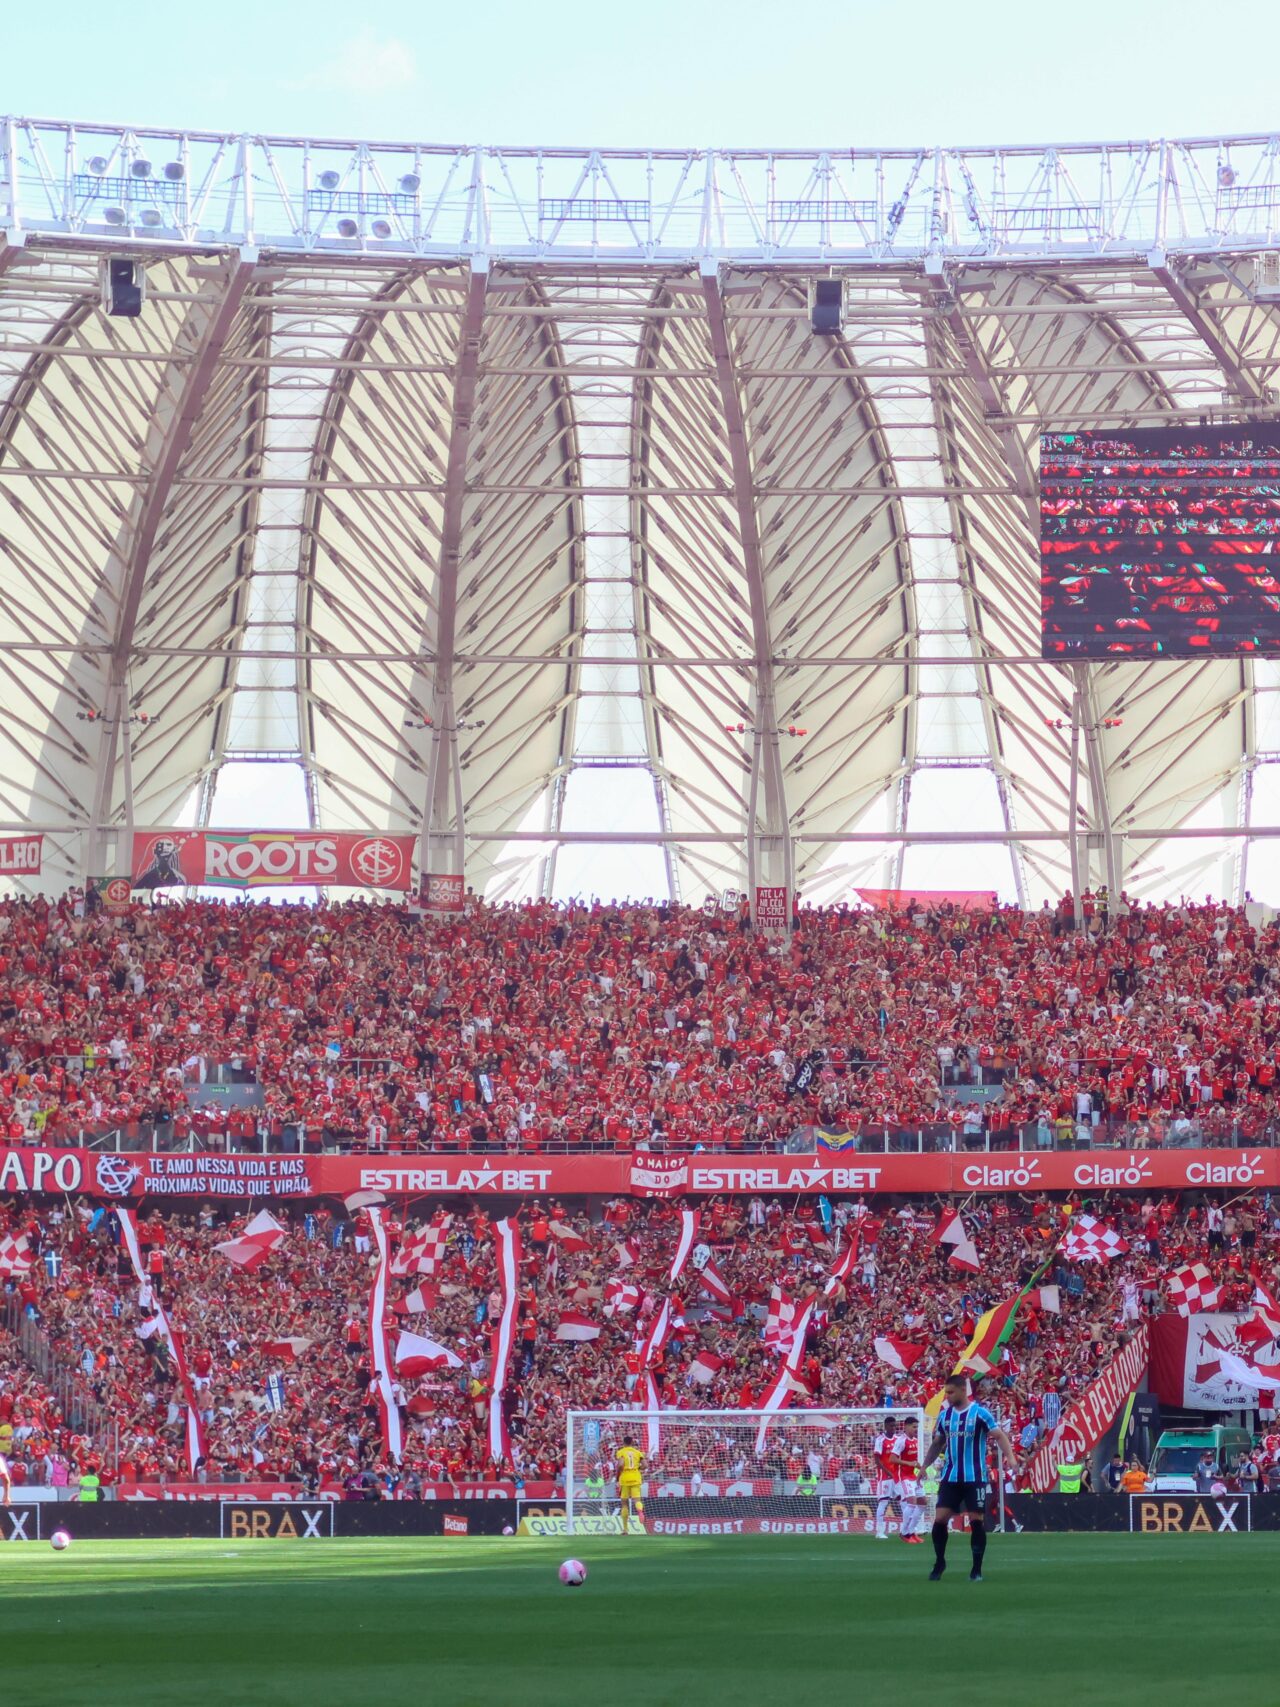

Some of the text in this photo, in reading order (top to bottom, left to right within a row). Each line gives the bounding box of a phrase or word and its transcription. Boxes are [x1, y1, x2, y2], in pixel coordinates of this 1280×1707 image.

[205, 839, 338, 878] ROOTS
[428, 892, 460, 903] ROOTS
[757, 917, 785, 928] INTER
[148, 1158, 304, 1176] TE AMO NESSA VIDA E NAS
[636, 1156, 644, 1166] O
[0, 1152, 81, 1192] APO
[360, 1169, 552, 1191] ESTRELA BET
[655, 1175, 670, 1184] DO
[692, 1168, 881, 1189] ESTRELA BET
[963, 1165, 1031, 1186] Claro
[1074, 1164, 1141, 1185] Claro
[1186, 1162, 1253, 1183] Claro
[144, 1175, 309, 1196] PRÓXIMAS VIDAS QUE VIRÃO
[628, 1452, 635, 1469] 1
[976, 1488, 986, 1501] 18
[231, 1510, 324, 1538] BRAX
[653, 1519, 743, 1535] SUPERBET
[760, 1519, 849, 1534] SUPERBET
[1141, 1502, 1239, 1532] BRAX
